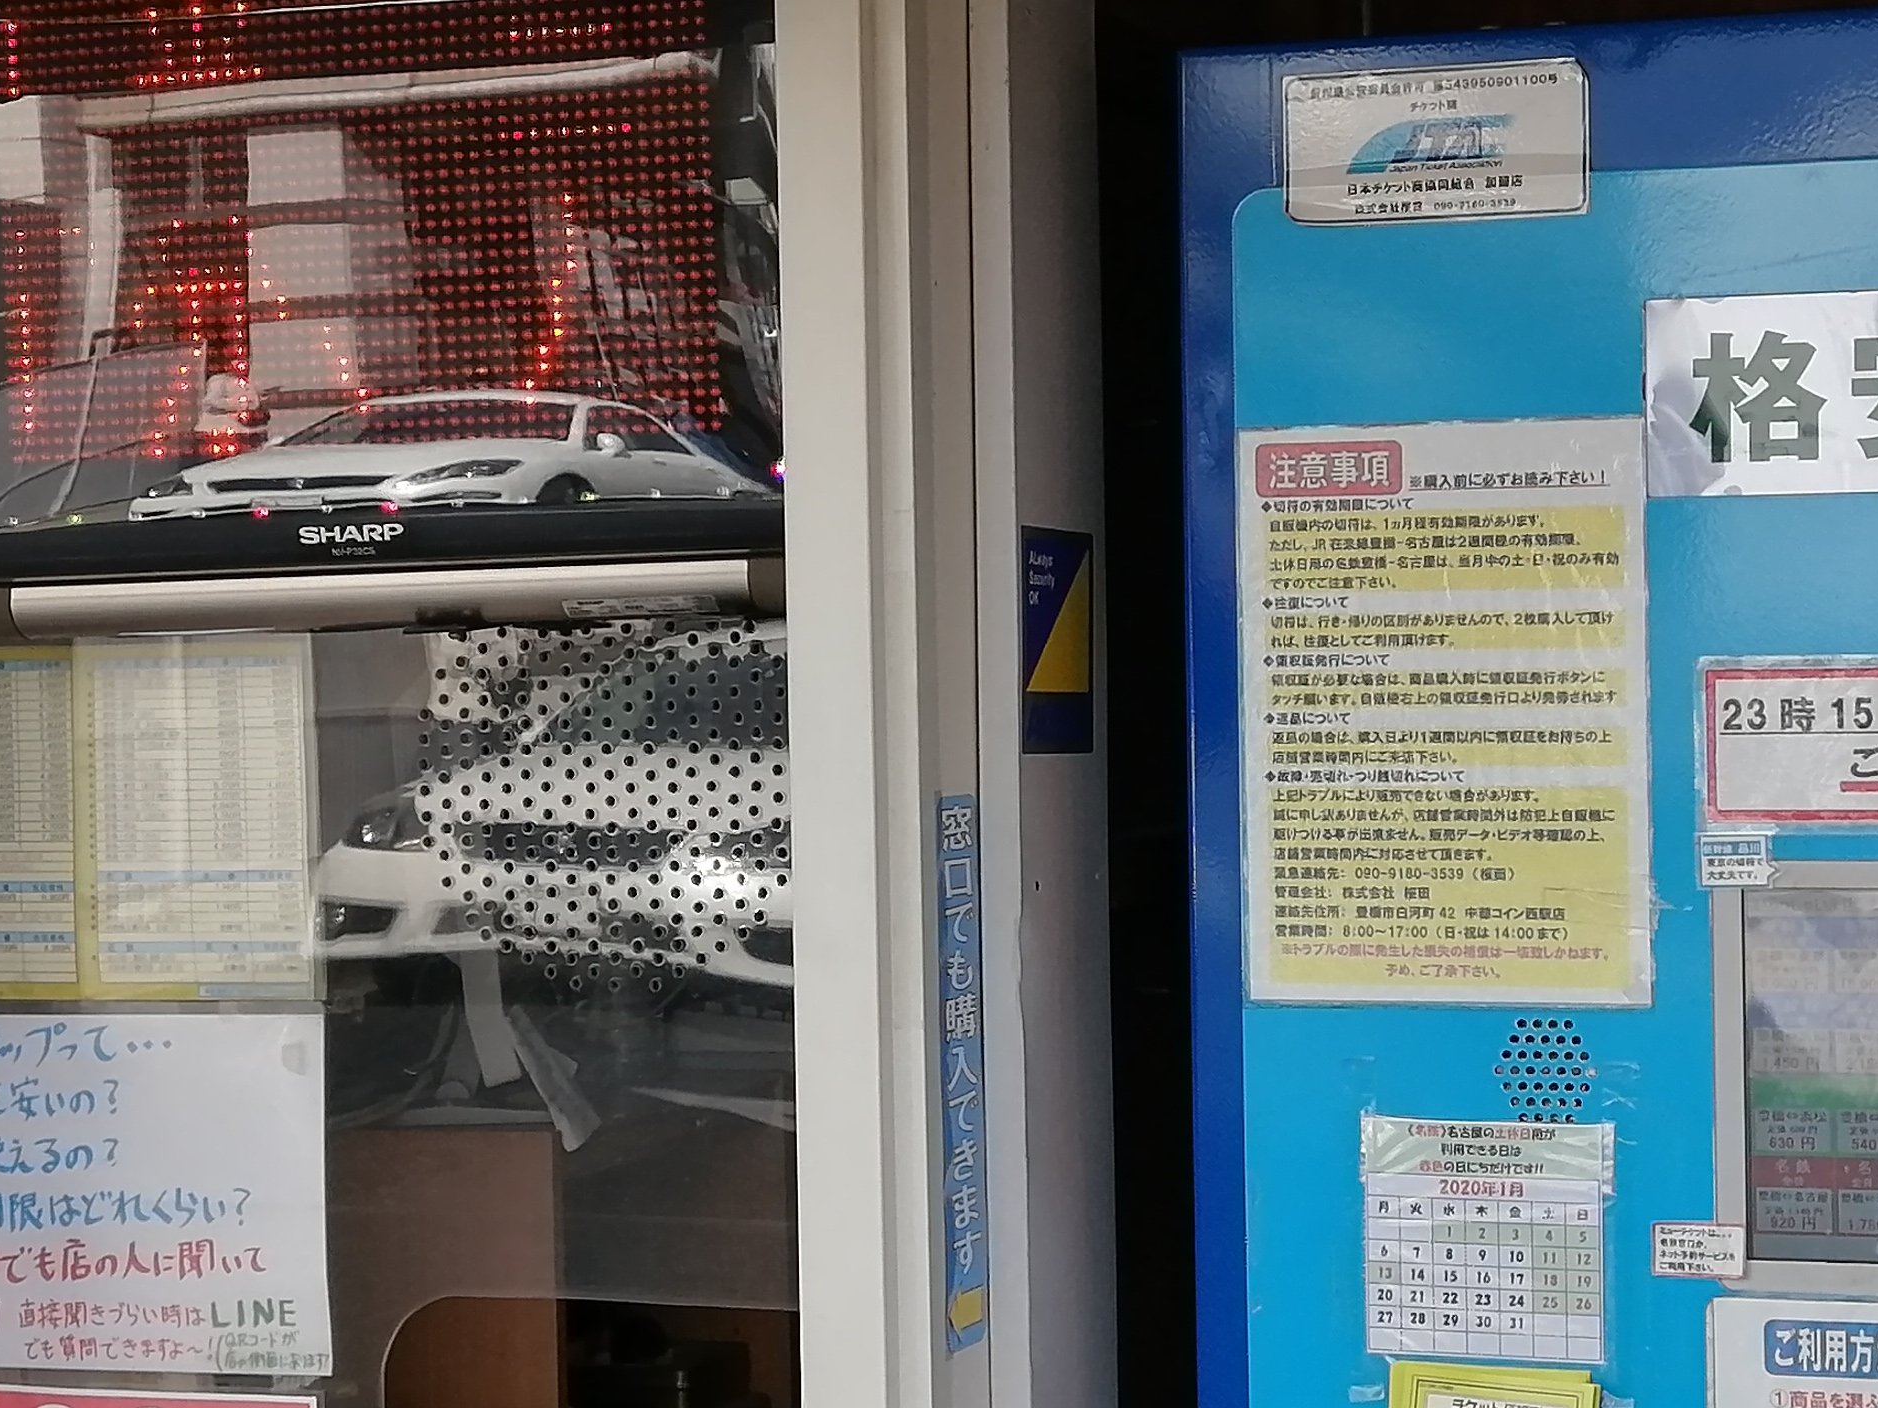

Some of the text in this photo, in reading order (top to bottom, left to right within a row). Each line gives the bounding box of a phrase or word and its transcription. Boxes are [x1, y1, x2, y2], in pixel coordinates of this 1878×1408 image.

[1269, 451, 1390, 490] 注意事項
[298, 523, 404, 544] SHARP
[1342, 886, 1395, 900] 株式会社
[940, 805, 984, 1277] 窓口でも購入できます
[1439, 1179, 1524, 1197] 2020年1月
[1509, 1251, 1524, 1262] 10
[1475, 1294, 1491, 1305] 23
[18, 1299, 298, 1328] 直接聞きづらい時は LINE
